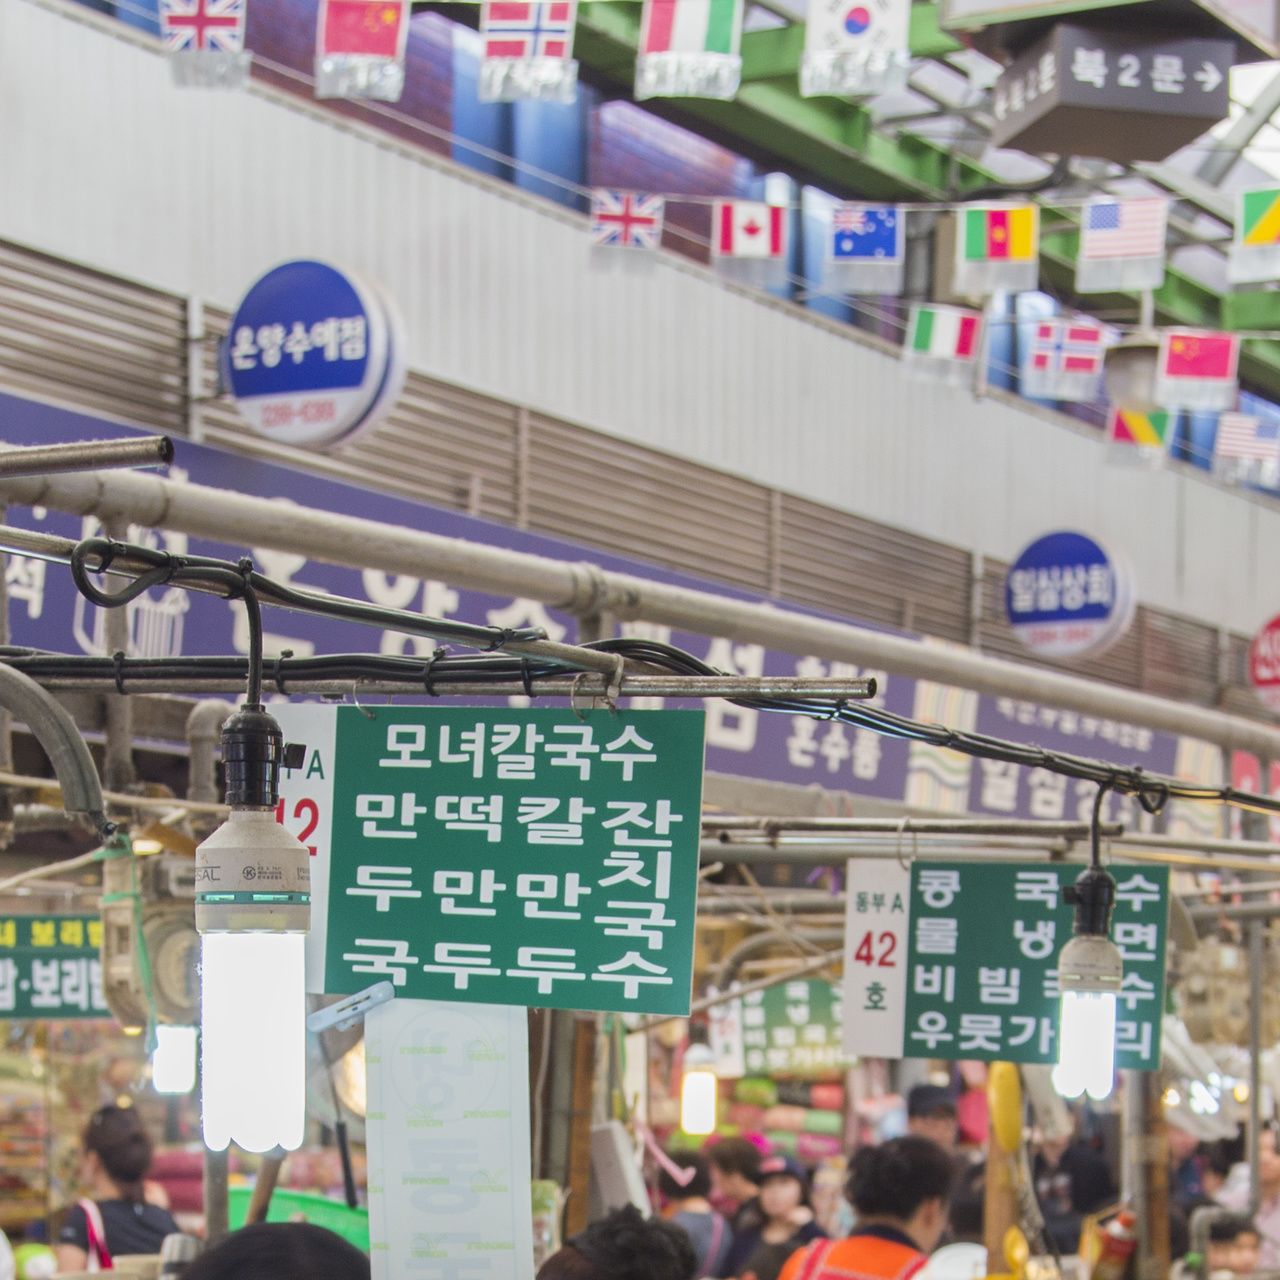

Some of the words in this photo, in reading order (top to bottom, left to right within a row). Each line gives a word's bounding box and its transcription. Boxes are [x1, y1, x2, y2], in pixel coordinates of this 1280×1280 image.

[379, 722, 657, 782] 모녀칼국수
[854, 930, 897, 967] 42
[863, 981, 888, 1011] 호
[910, 1011, 1153, 1061] 우뭇가리
